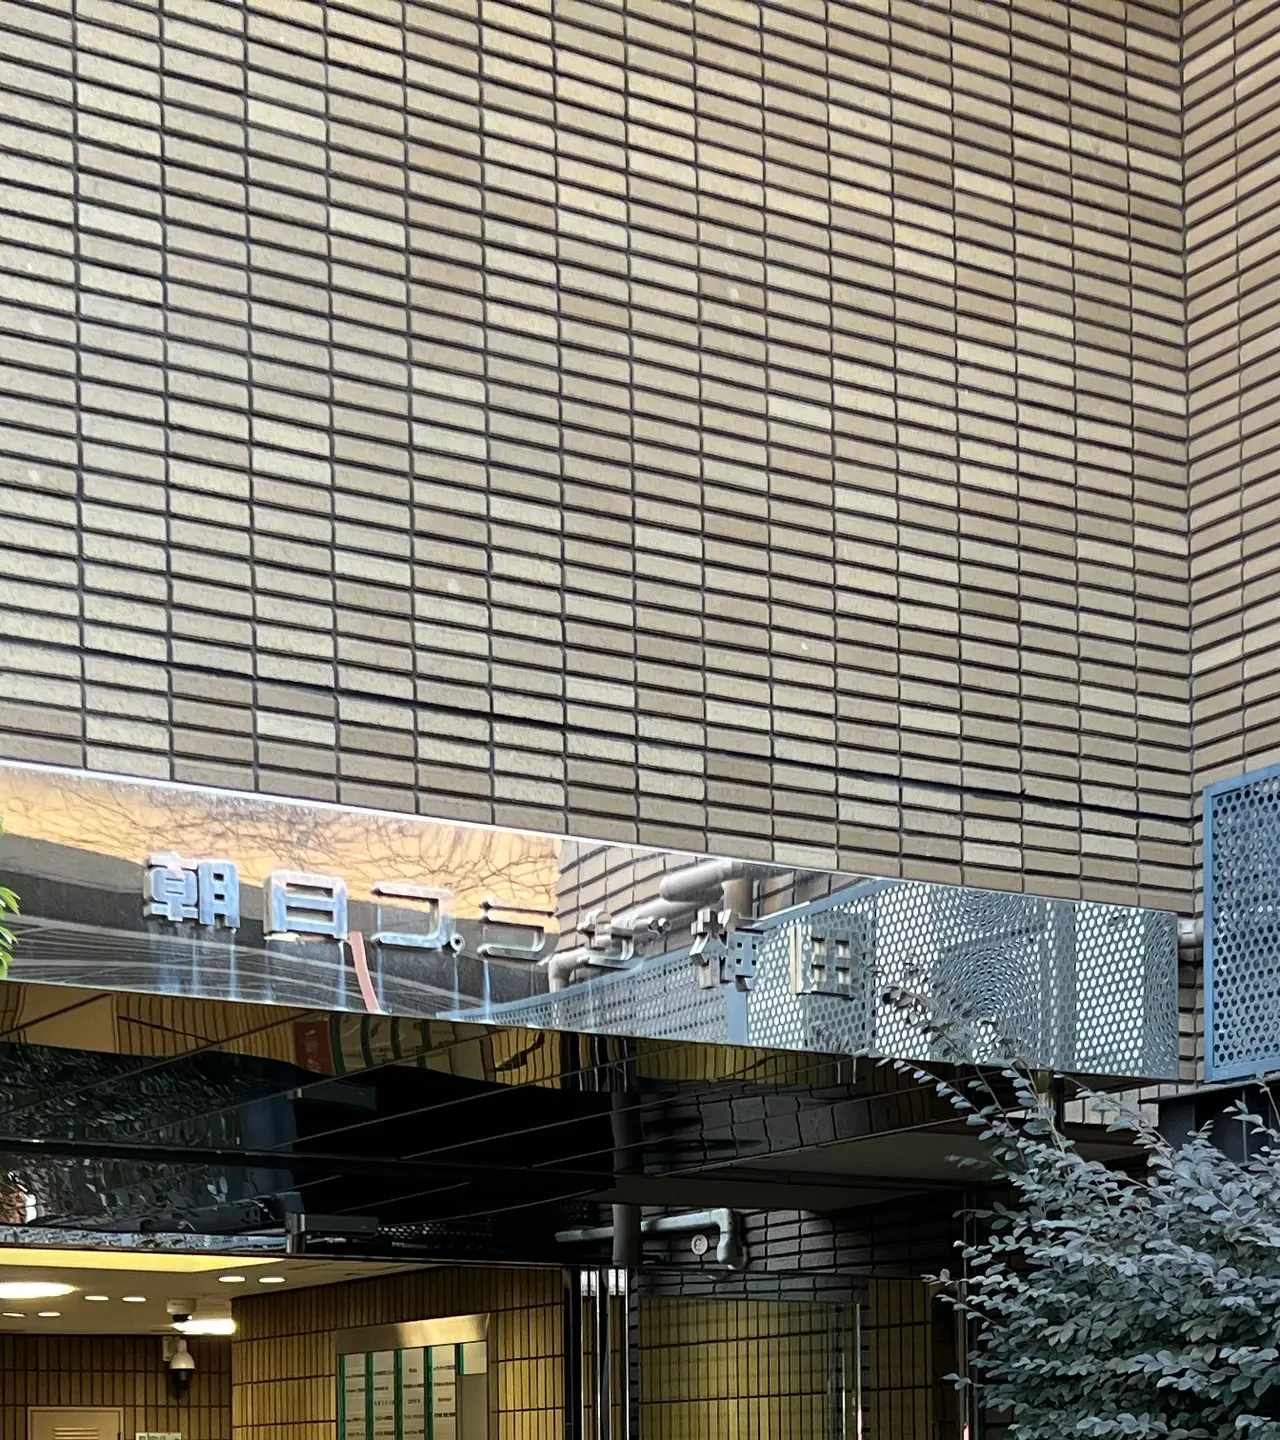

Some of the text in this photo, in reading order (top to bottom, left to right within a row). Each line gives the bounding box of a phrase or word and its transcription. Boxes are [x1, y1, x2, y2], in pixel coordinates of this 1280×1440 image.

[143, 850, 854, 999] 朝日プラザ梅田
